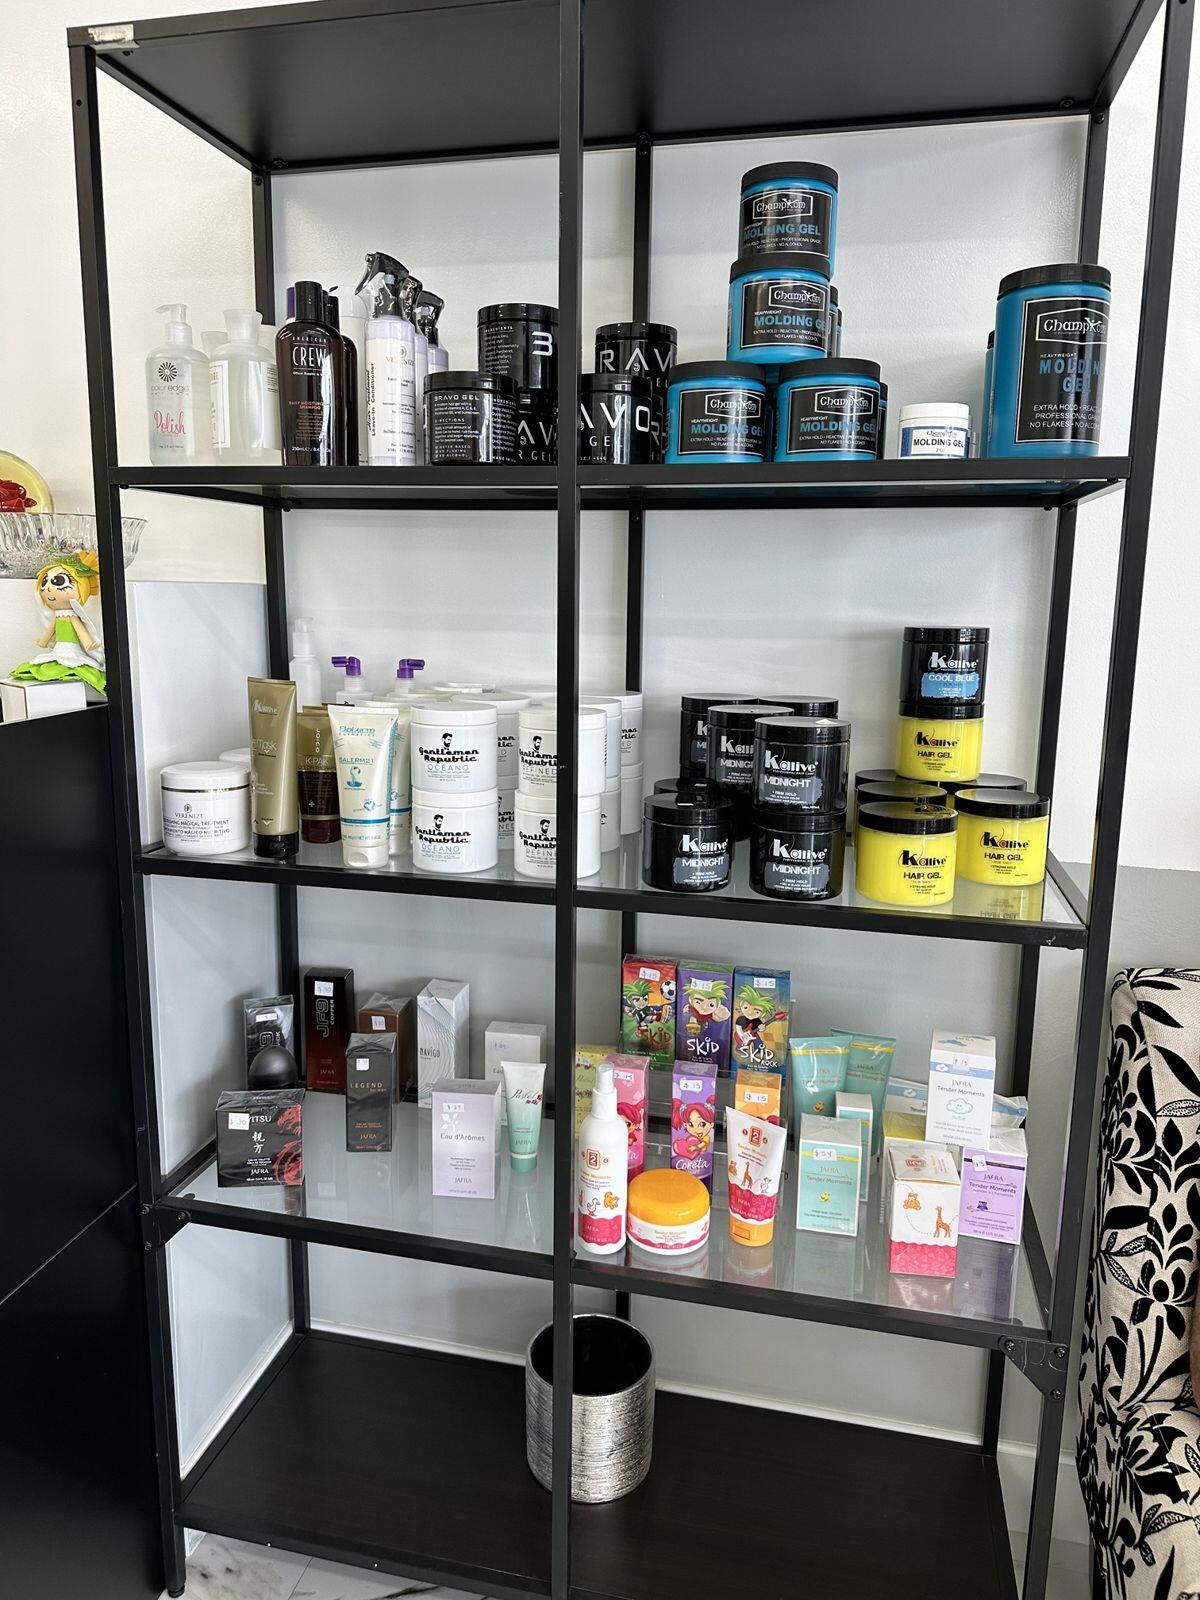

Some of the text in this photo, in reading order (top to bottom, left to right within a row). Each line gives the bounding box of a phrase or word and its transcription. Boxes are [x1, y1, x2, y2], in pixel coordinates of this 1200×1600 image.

[744, 224, 821, 240] MOLDING GEL
[754, 315, 813, 327] MOLDING
[292, 346, 327, 368] CREW
[600, 347, 672, 373] RAV
[1062, 377, 1091, 393] GEL
[434, 394, 459, 402] BRAVO
[1035, 412, 1087, 420] PROFESSIONAL
[154, 410, 186, 435] Polish
[800, 421, 860, 432] MOLDING
[690, 424, 749, 434] MOLDING
[913, 438, 964, 448] MOLDING GEL
[928, 674, 975, 682] COOL BLUE
[720, 736, 753, 754] Kali
[419, 746, 480, 756] Gentlemen
[519, 748, 557, 758] entleme
[937, 751, 952, 759] GEL
[424, 755, 477, 763] Republic
[520, 757, 557, 766] Republi
[720, 759, 753, 769] MIDNIG
[764, 775, 811, 788] MIDNIGHT
[415, 826, 471, 837] Gentlemen
[519, 831, 556, 842] Gentlem
[418, 834, 470, 844] Republic
[523, 839, 556, 849] Repub
[1007, 853, 1023, 861] GEL
[682, 857, 724, 868] MIDNIGHT
[772, 863, 821, 875] MIDNIGHT
[903, 872, 924, 880] HAIR
[952, 1080, 972, 1088] JAFRA
[937, 1085, 985, 1098] Tender Moments
[675, 1158, 711, 1170] Coreta
[984, 1173, 1004, 1182] JAFRA
[969, 1182, 1016, 1194] Tender Moments
